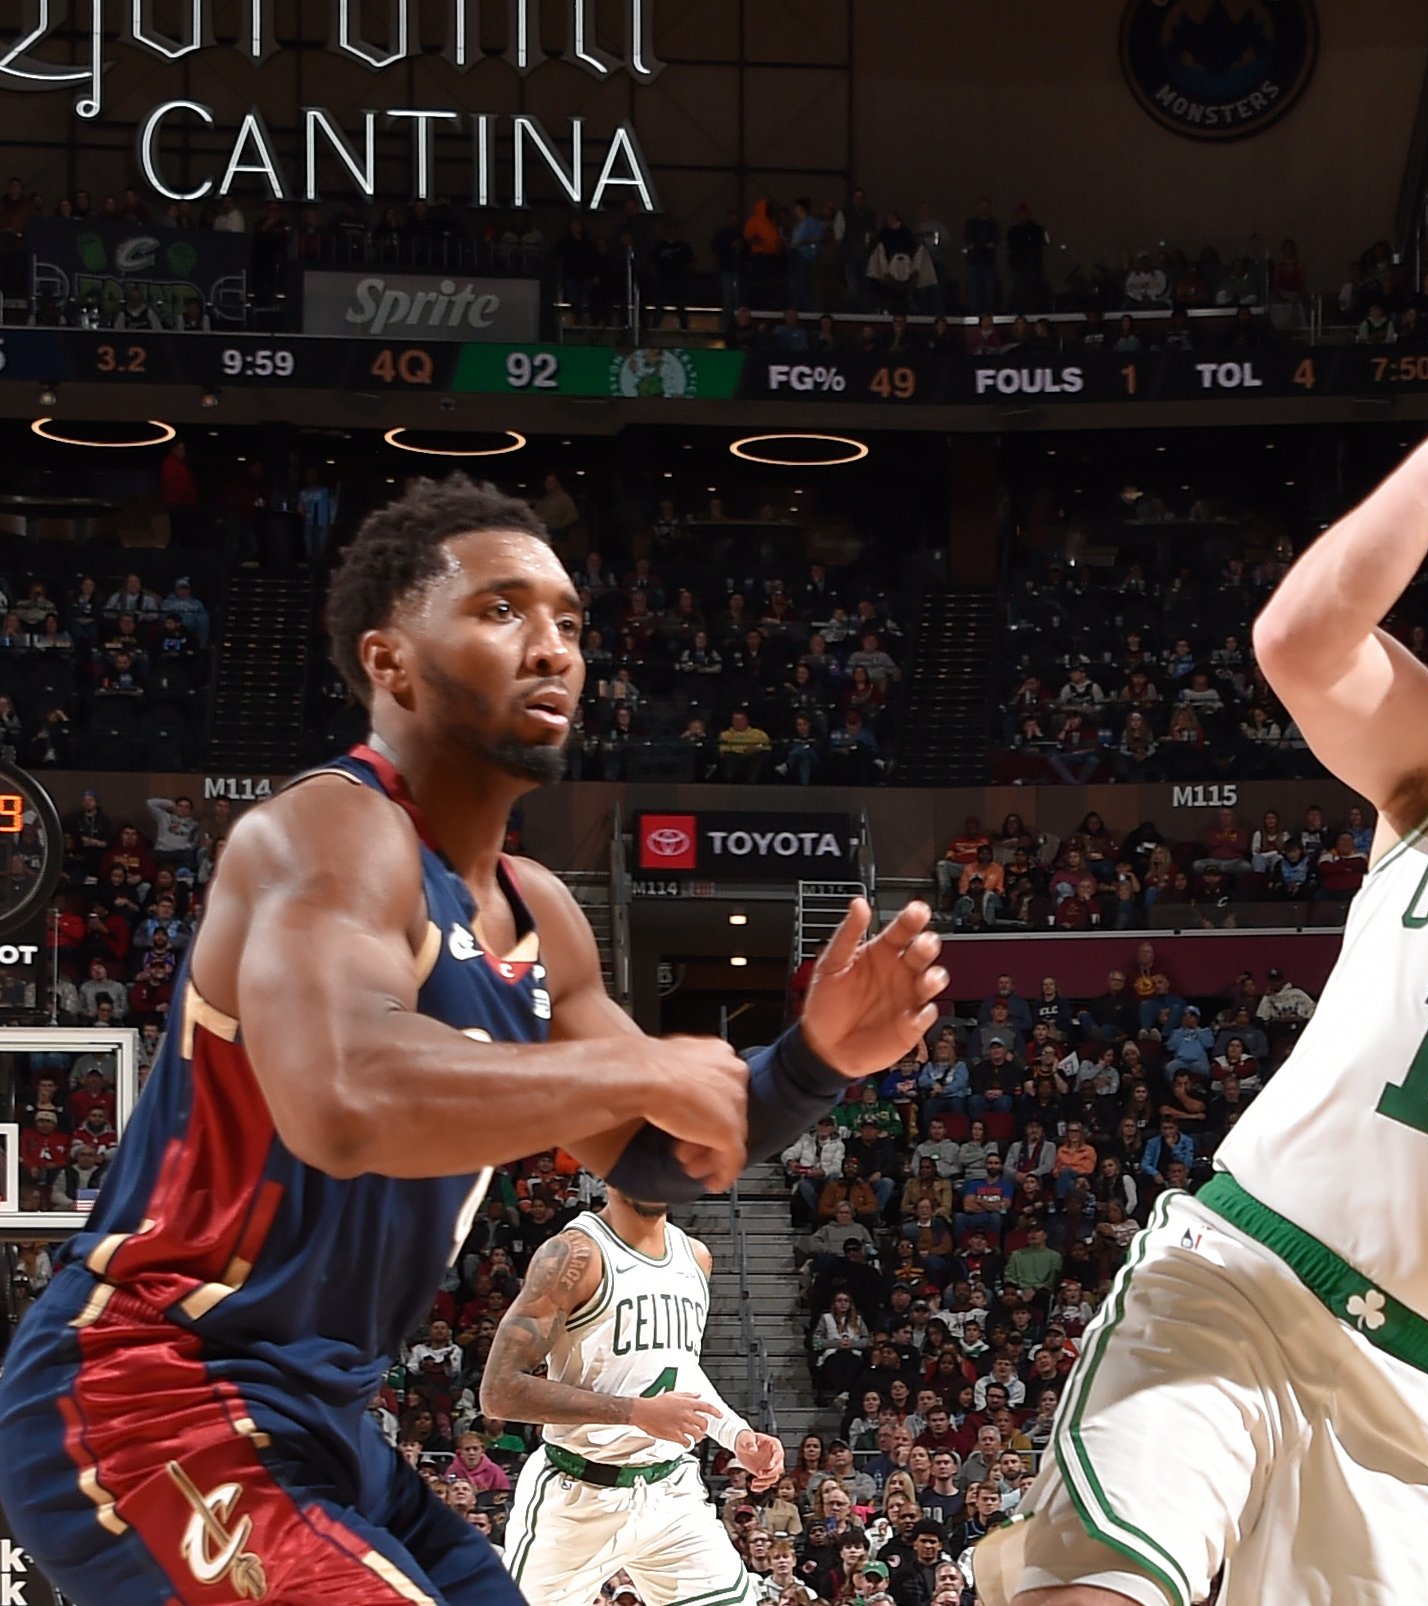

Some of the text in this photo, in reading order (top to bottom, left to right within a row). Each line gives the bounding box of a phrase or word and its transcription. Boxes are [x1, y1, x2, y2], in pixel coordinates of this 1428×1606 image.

[1155, 80, 1280, 124] MONSTERS
[140, 101, 653, 211] CANTINA
[345, 277, 502, 334] Sprite
[96, 344, 148, 374] 3.2
[222, 349, 296, 377] 9:59
[371, 350, 434, 384] 4Q
[506, 353, 559, 388] 92
[768, 364, 846, 392] FG%
[870, 366, 916, 398] 49
[975, 367, 1084, 394] FOULS
[1120, 362, 1138, 394] 1
[1195, 361, 1263, 389] TOL
[1293, 357, 1316, 389] 4
[204, 777, 273, 800] M114
[1172, 784, 1238, 807] M115
[707, 832, 842, 857] TOYOTA
[632, 881, 679, 895] M114
